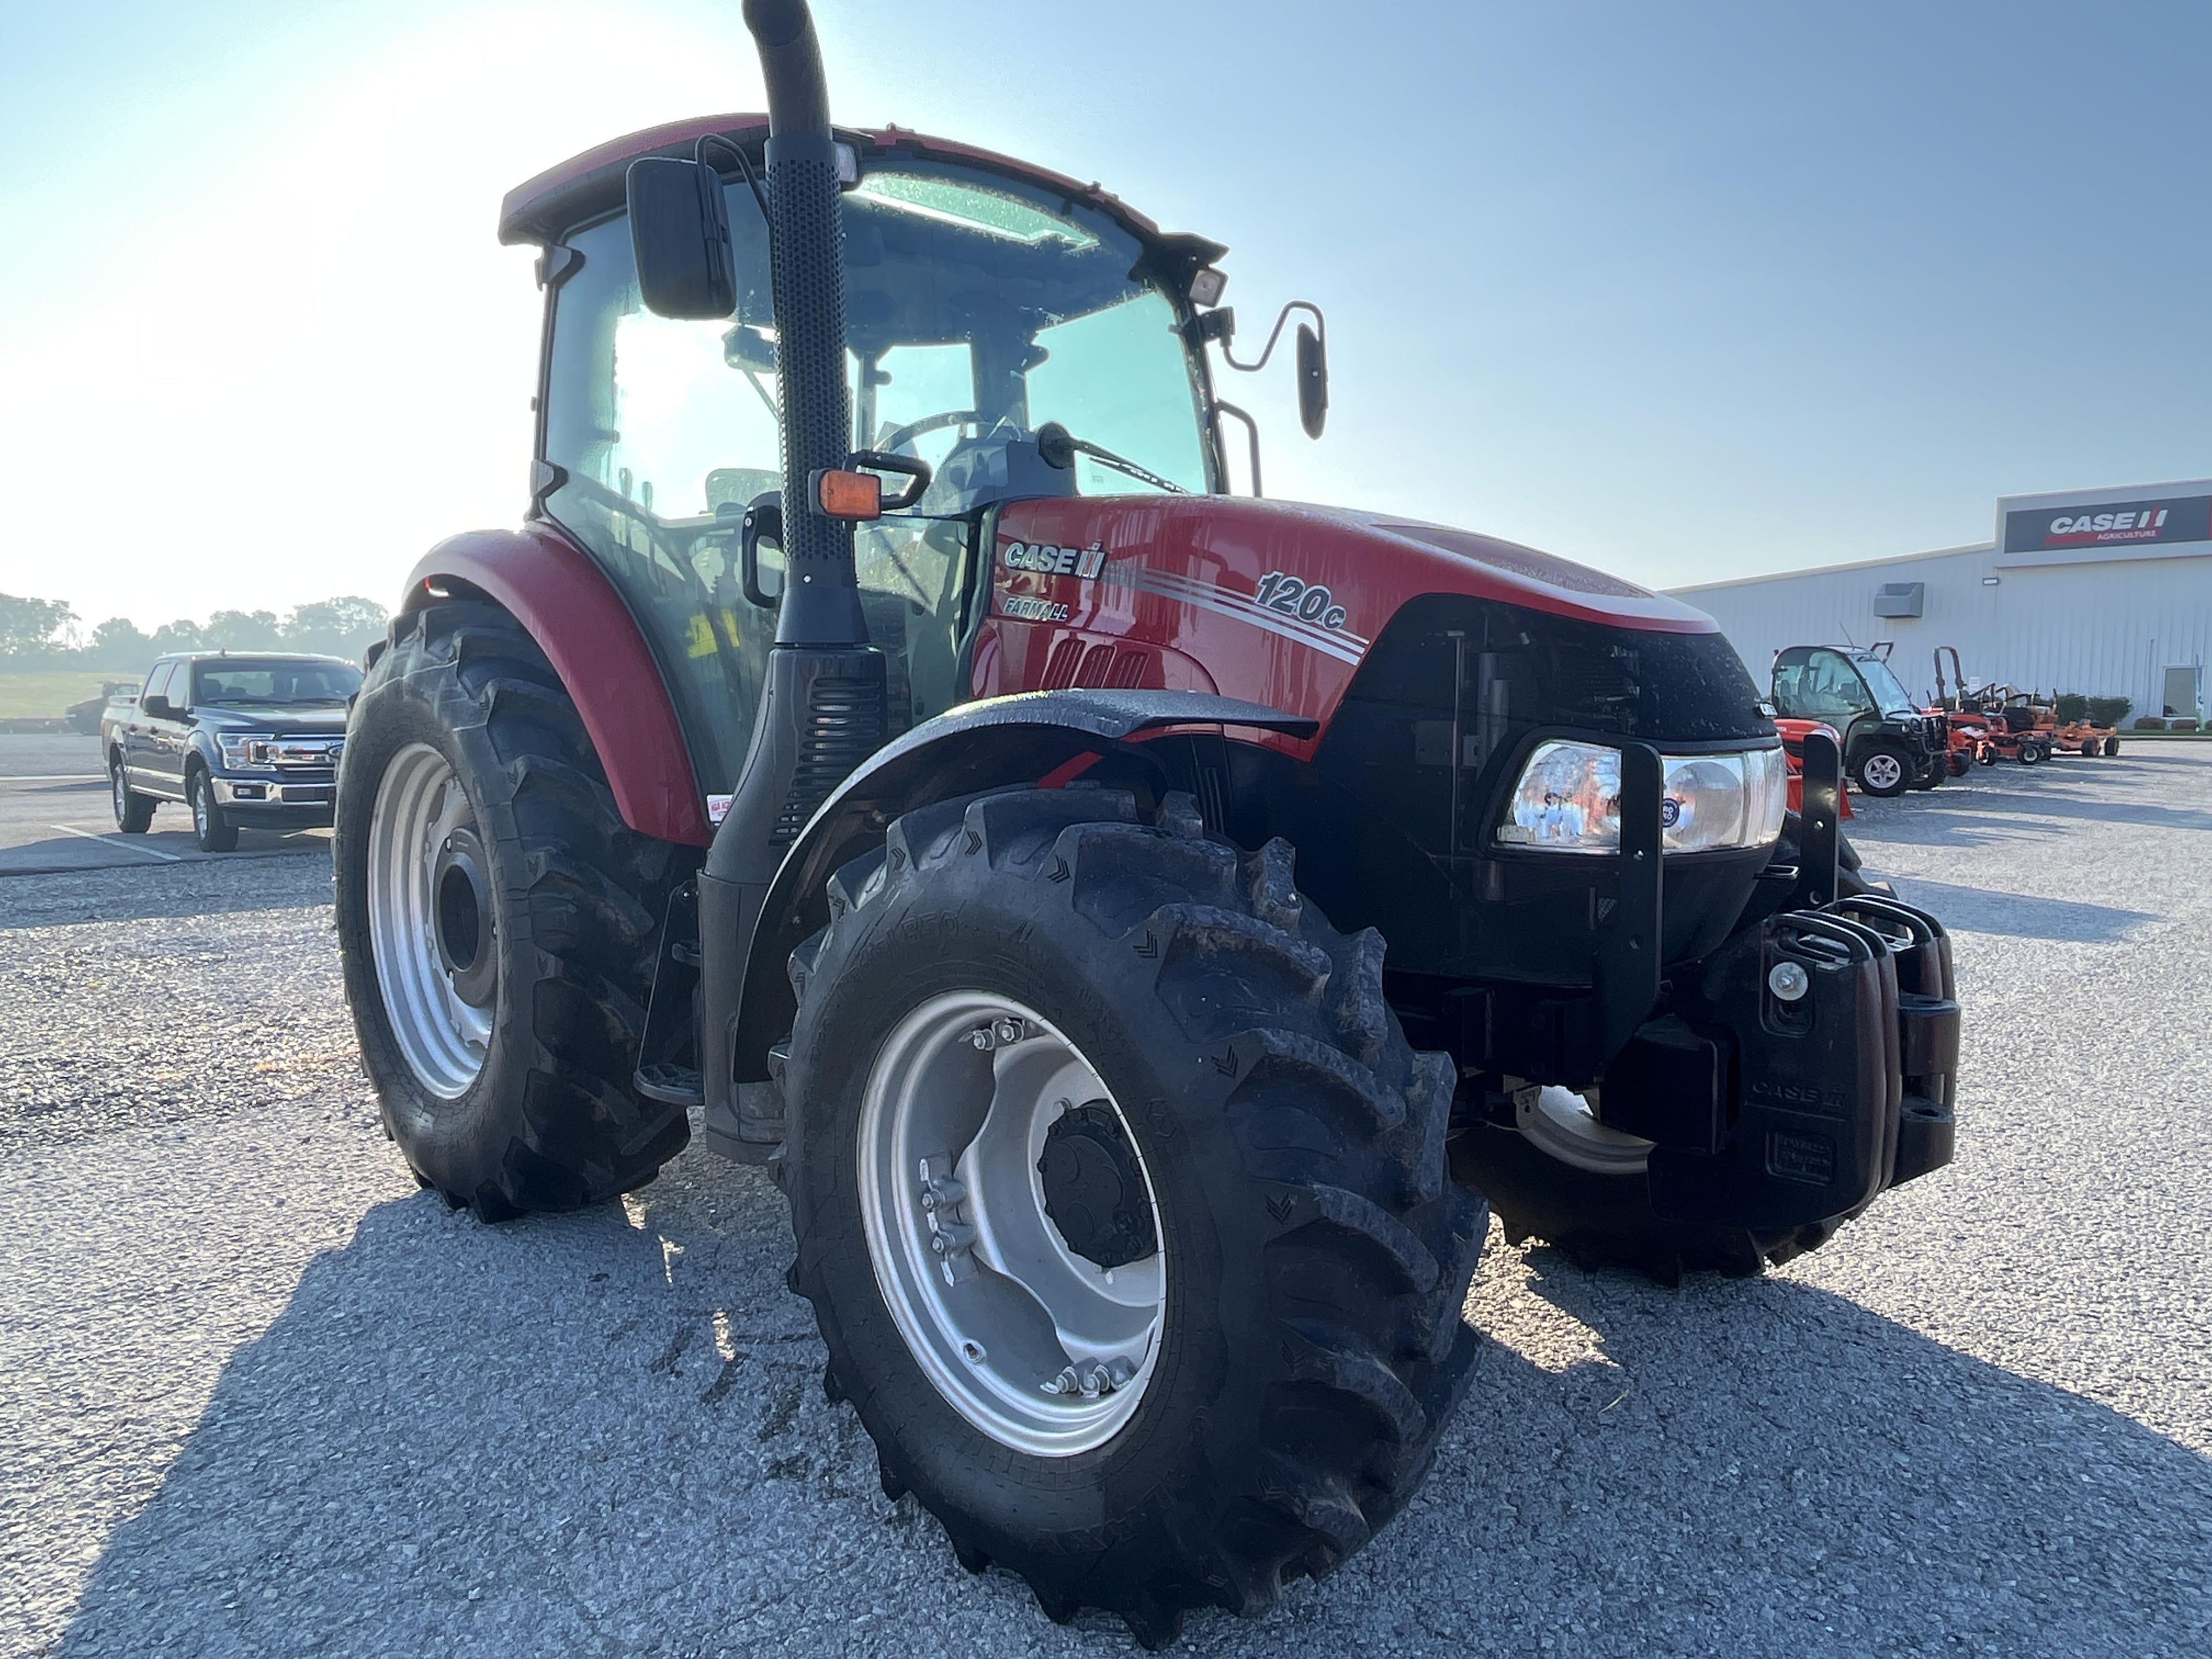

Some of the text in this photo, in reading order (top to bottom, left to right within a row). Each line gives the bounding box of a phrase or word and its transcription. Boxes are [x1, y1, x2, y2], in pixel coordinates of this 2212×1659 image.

[2050, 511, 2136, 534] CASE
[2096, 530, 2157, 540] AGRICULTURE
[1005, 541, 1076, 574] CASE
[1003, 597, 1069, 622] FARMALL
[1752, 1081, 1818, 1103] CASE
